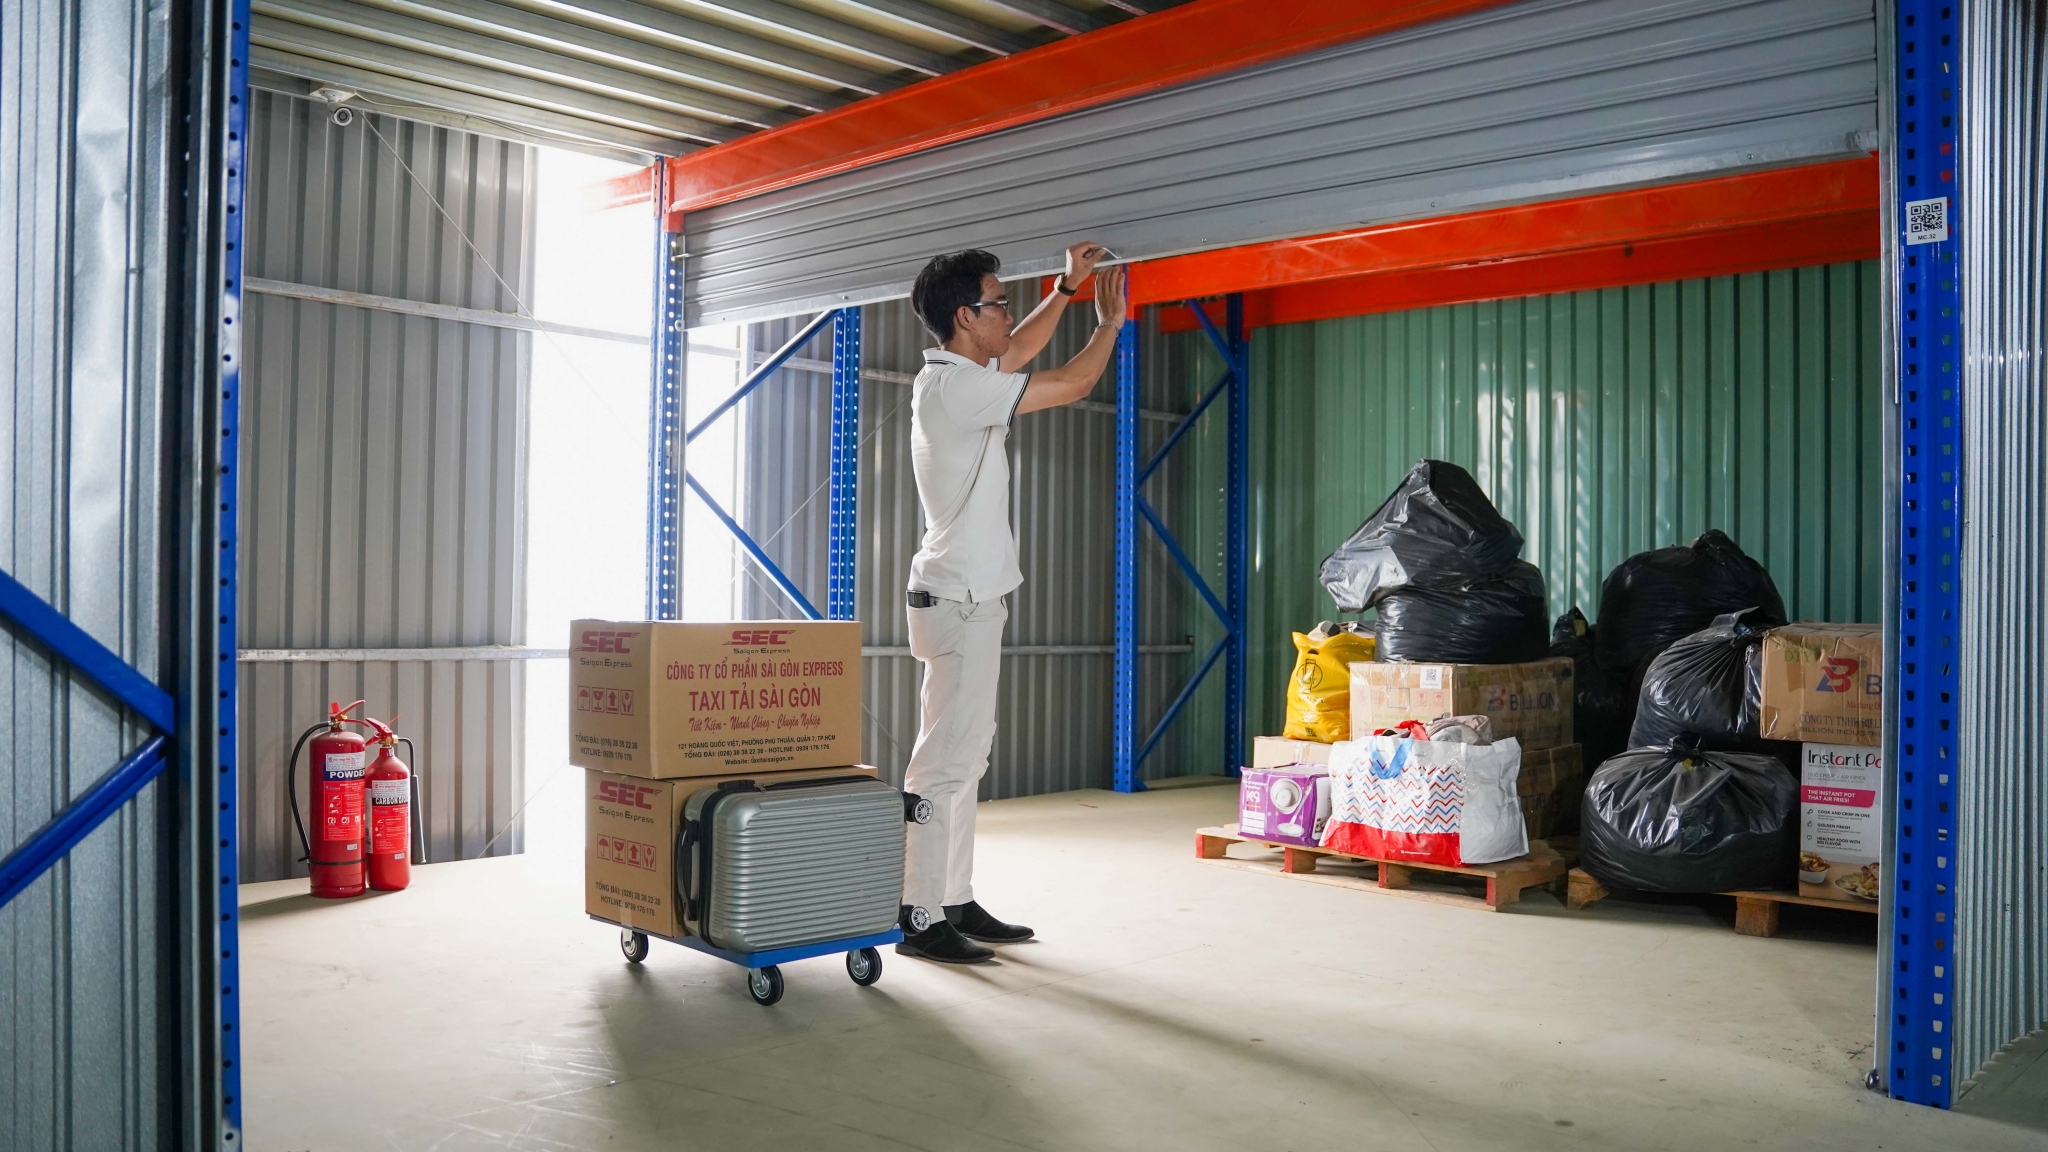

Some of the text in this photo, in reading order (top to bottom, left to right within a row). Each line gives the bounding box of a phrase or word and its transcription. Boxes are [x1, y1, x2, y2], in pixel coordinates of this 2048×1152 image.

[579, 631, 634, 654] SEC
[731, 630, 789, 645] SEC
[733, 647, 791, 655] Saigon Express
[580, 657, 632, 668] Saigon Express
[666, 656, 843, 680] CÔNG TY CỔ PHẦN SÀI GÒN EXPRESS
[1866, 674, 1882, 695] B
[689, 682, 821, 711] TAXI TẢI SÀI GÒN
[730, 715, 750, 731] Nhanh
[1800, 711, 1821, 725] CÔNG
[1823, 715, 1834, 726] TY
[1837, 728, 1882, 737] INDUSTR
[613, 739, 619, 747] 38
[619, 740, 625, 748] 38
[625, 741, 631, 749] 22
[632, 742, 638, 750] 38
[689, 740, 709, 749] HOÀNG
[710, 739, 726, 748] QUỐC
[684, 750, 702, 759] TỔNG
[768, 746, 795, 754] HOTLINE:
[1808, 750, 1861, 767] Instant
[1866, 753, 1882, 768] Po
[725, 758, 750, 766] Website:
[330, 770, 365, 778] POWDE
[600, 780, 653, 810] SEC
[599, 806, 654, 824] Saigon Express
[634, 892, 640, 900] 38
[641, 894, 647, 902] 38
[647, 896, 654, 904] 22
[654, 897, 661, 906] 38
